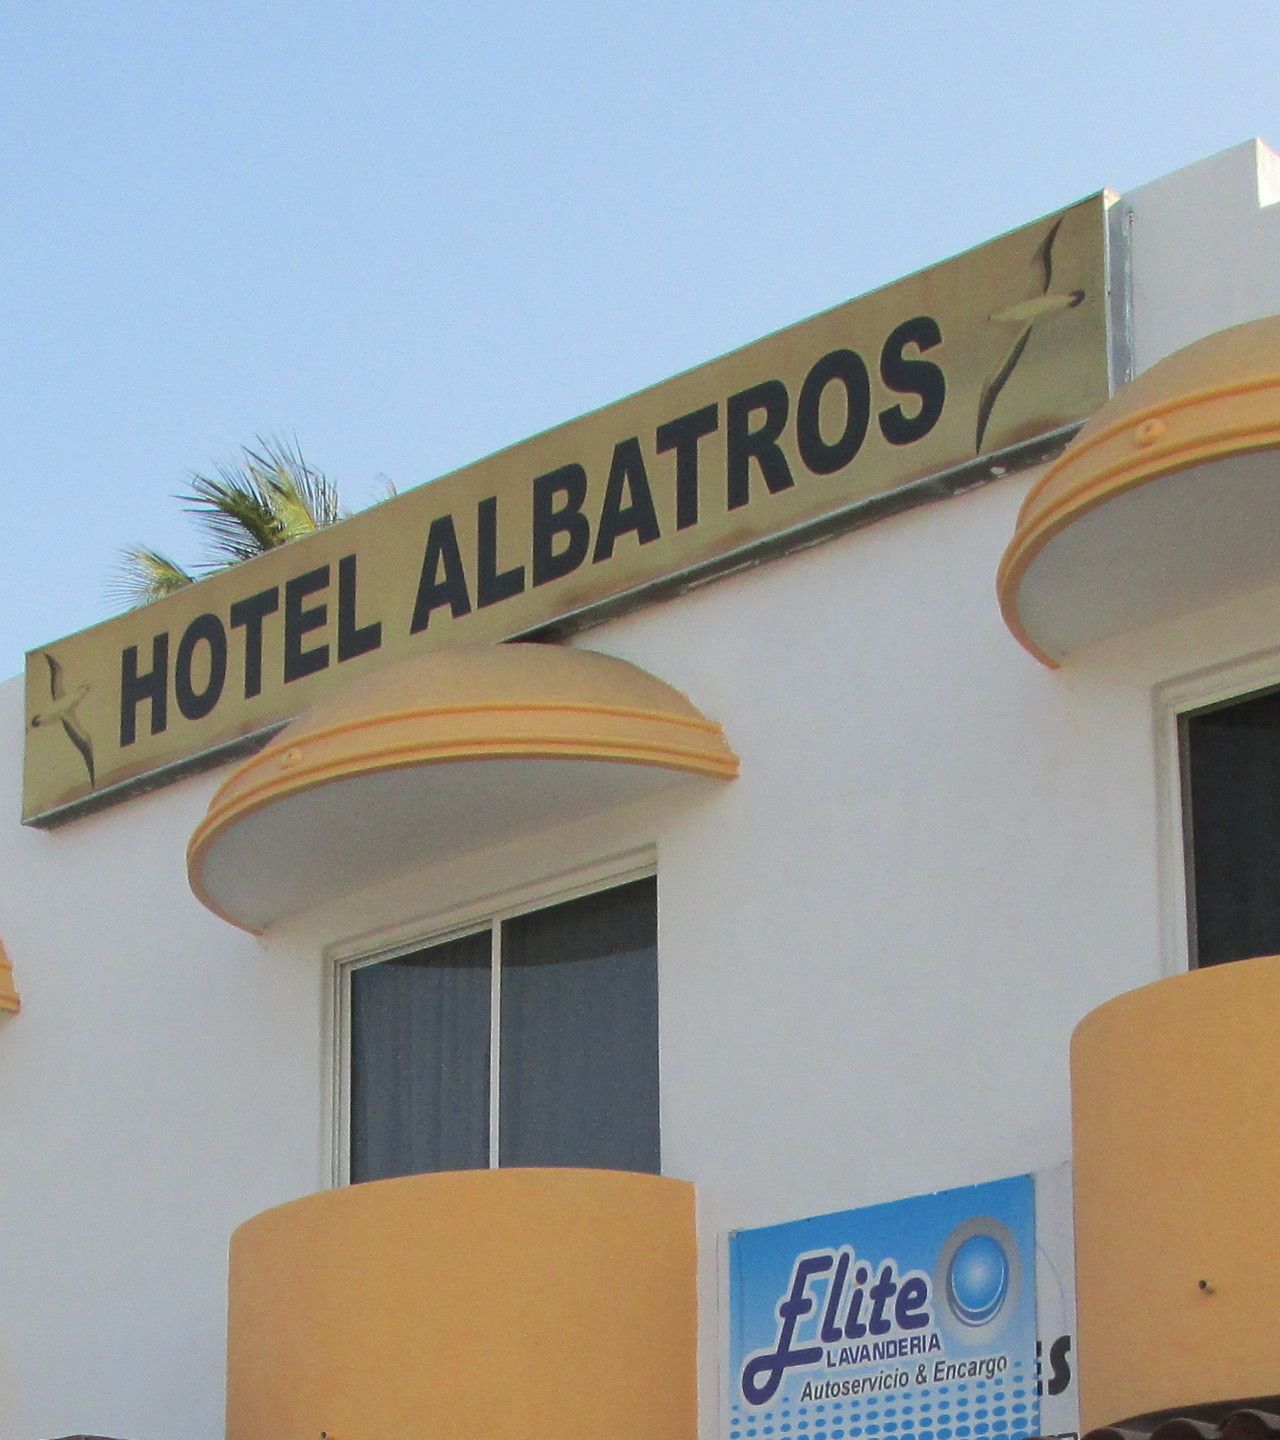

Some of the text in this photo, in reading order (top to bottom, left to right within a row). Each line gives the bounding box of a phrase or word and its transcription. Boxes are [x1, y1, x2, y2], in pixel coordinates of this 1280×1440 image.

[119, 315, 948, 748] HOTEL ALBATROS
[741, 1251, 931, 1406] Elite
[800, 1353, 1009, 1403] Autoservicio & Encargo
[826, 1332, 942, 1368] LAVANDERIA
